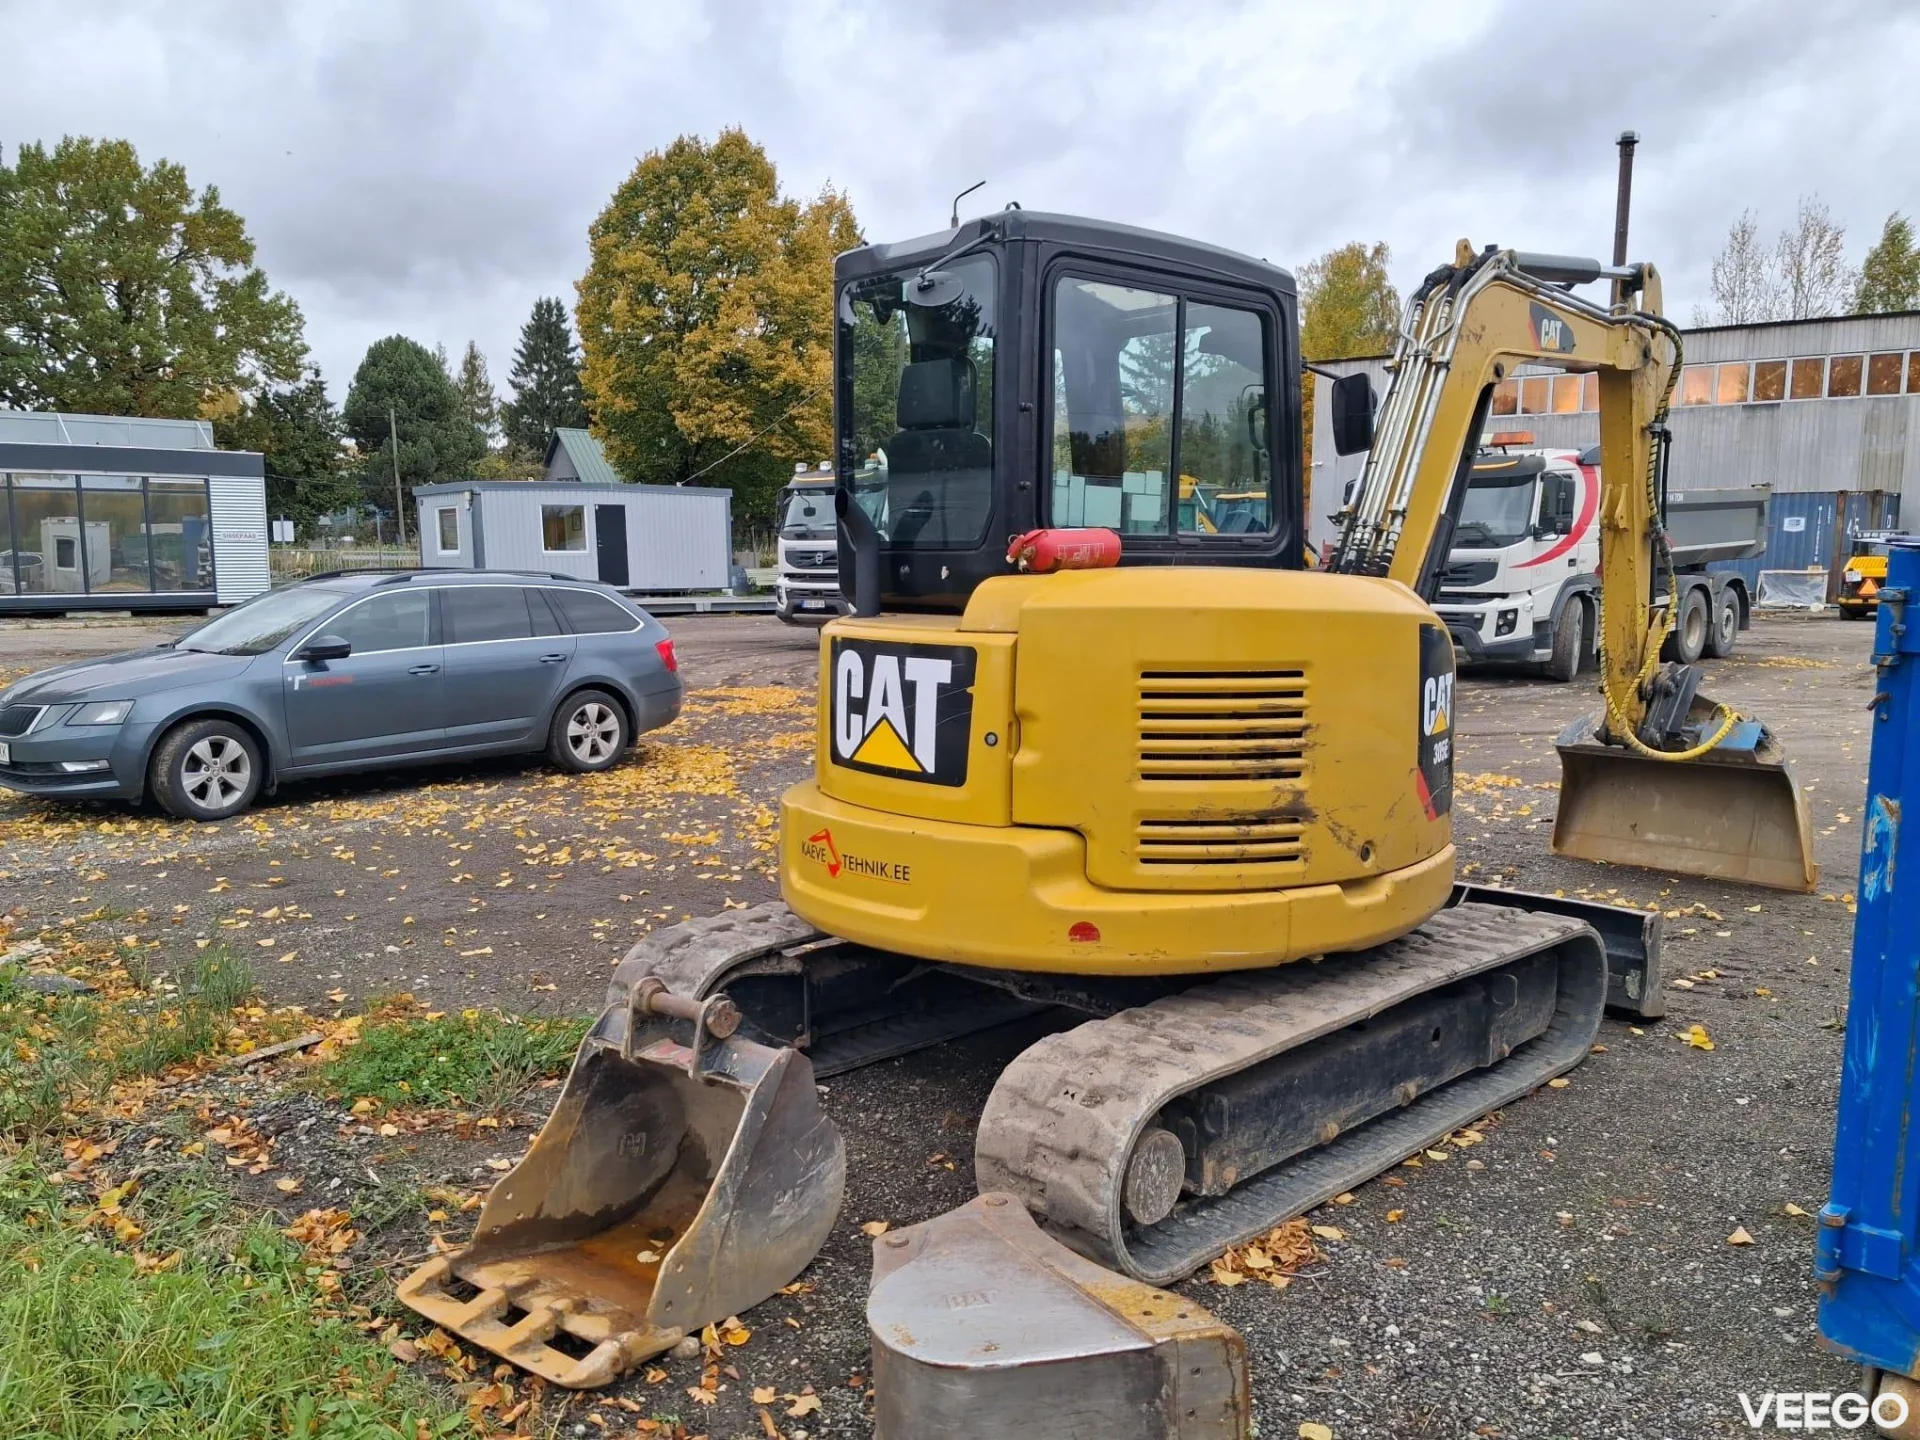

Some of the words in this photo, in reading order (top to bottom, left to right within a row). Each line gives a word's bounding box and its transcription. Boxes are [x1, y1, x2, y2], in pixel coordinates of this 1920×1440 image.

[1541, 318, 1562, 349] CAT
[836, 649, 952, 774] CAT
[1423, 671, 1453, 737] CAT
[801, 840, 827, 863] KAEVE
[842, 854, 911, 882] TEHNIK.EE
